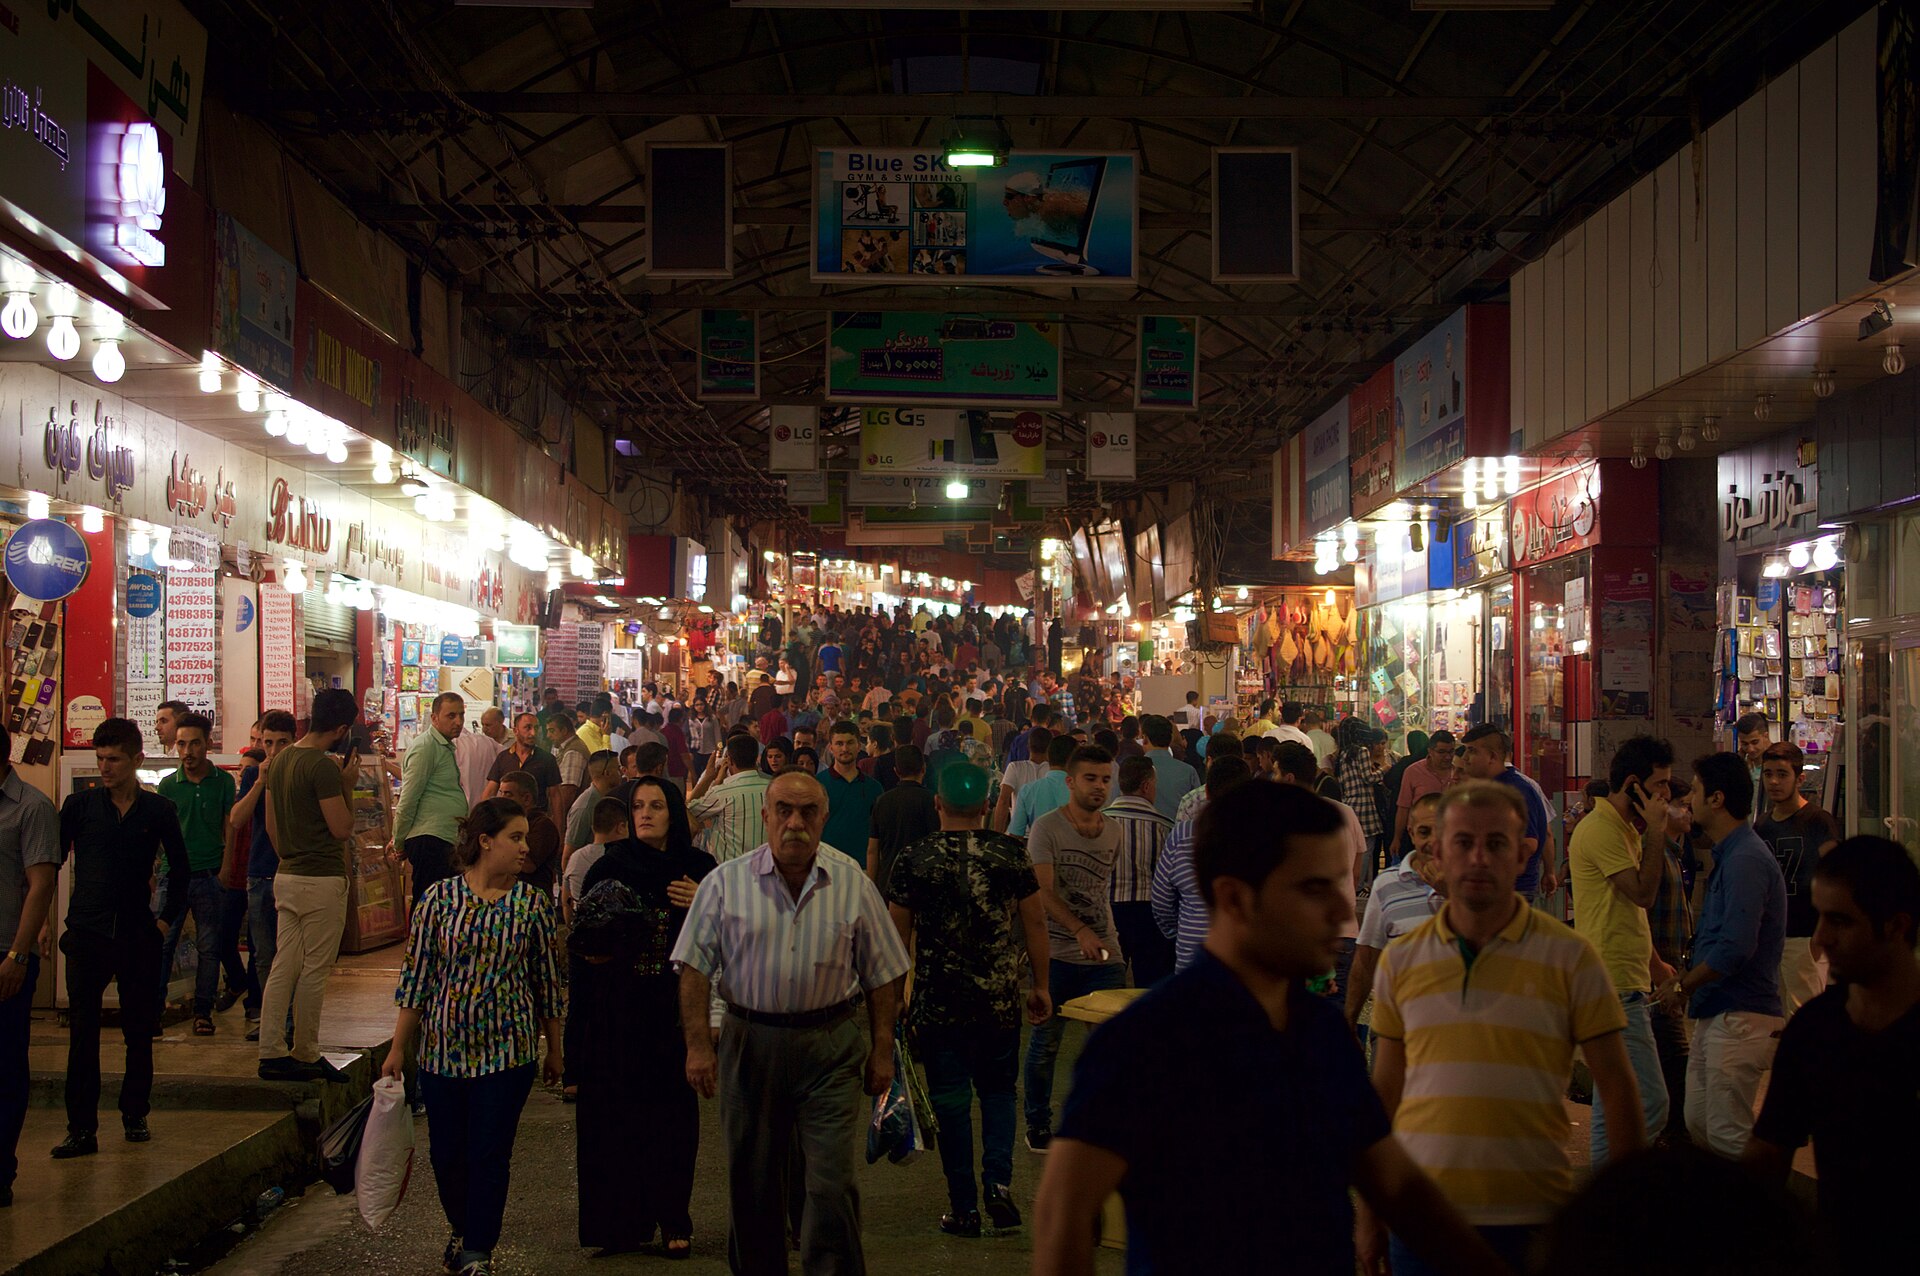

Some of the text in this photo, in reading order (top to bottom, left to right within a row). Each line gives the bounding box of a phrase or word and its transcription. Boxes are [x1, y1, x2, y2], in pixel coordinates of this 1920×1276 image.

[848, 154, 958, 172] Blue SK
[896, 174, 962, 182] SWIMMING
[866, 408, 925, 427] LG G5
[794, 428, 812, 439] LG
[1110, 434, 1128, 446] LG
[880, 456, 893, 464] LG
[1312, 475, 1342, 522] SAMSUNG
[1723, 474, 1770, 542] فون
[168, 577, 214, 586] 4378580
[168, 596, 213, 605] 4379295
[168, 610, 213, 619] 4198385
[168, 628, 213, 638] 4387371
[168, 642, 212, 652] 4372523
[168, 660, 212, 670] 4376264
[169, 674, 214, 684] 4387279
